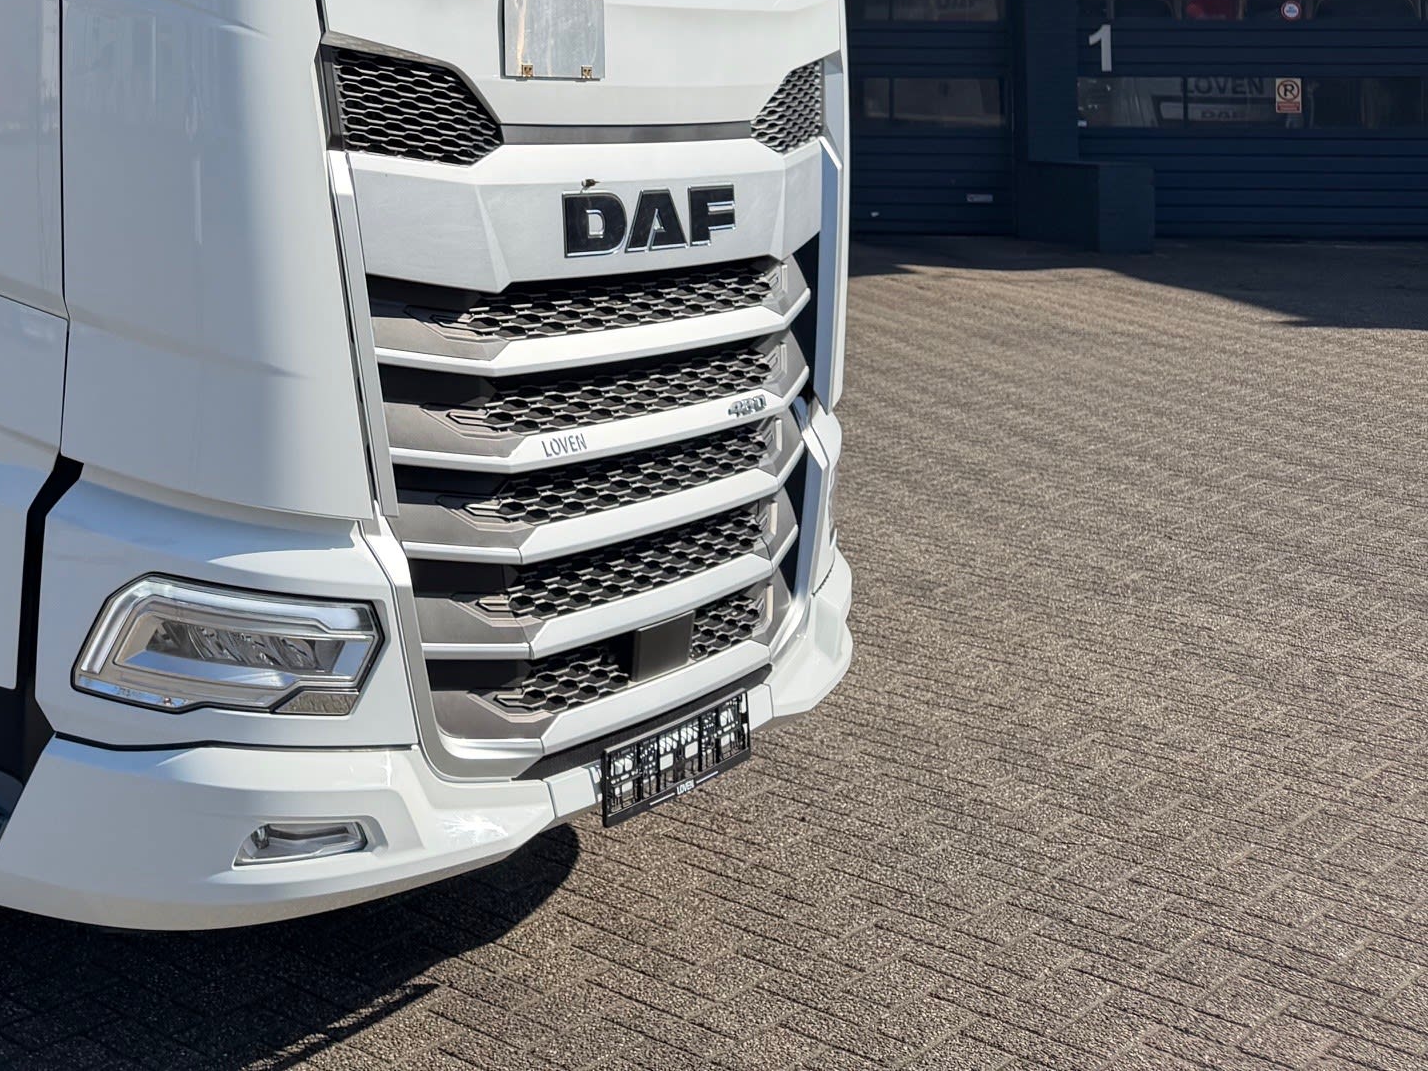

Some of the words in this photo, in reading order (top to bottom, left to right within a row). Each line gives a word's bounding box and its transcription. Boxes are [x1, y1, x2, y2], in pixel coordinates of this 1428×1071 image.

[1088, 24, 1112, 72] 1
[561, 183, 737, 258] DAF
[541, 433, 587, 457] LOVEN
[676, 779, 695, 796] LOVEN
